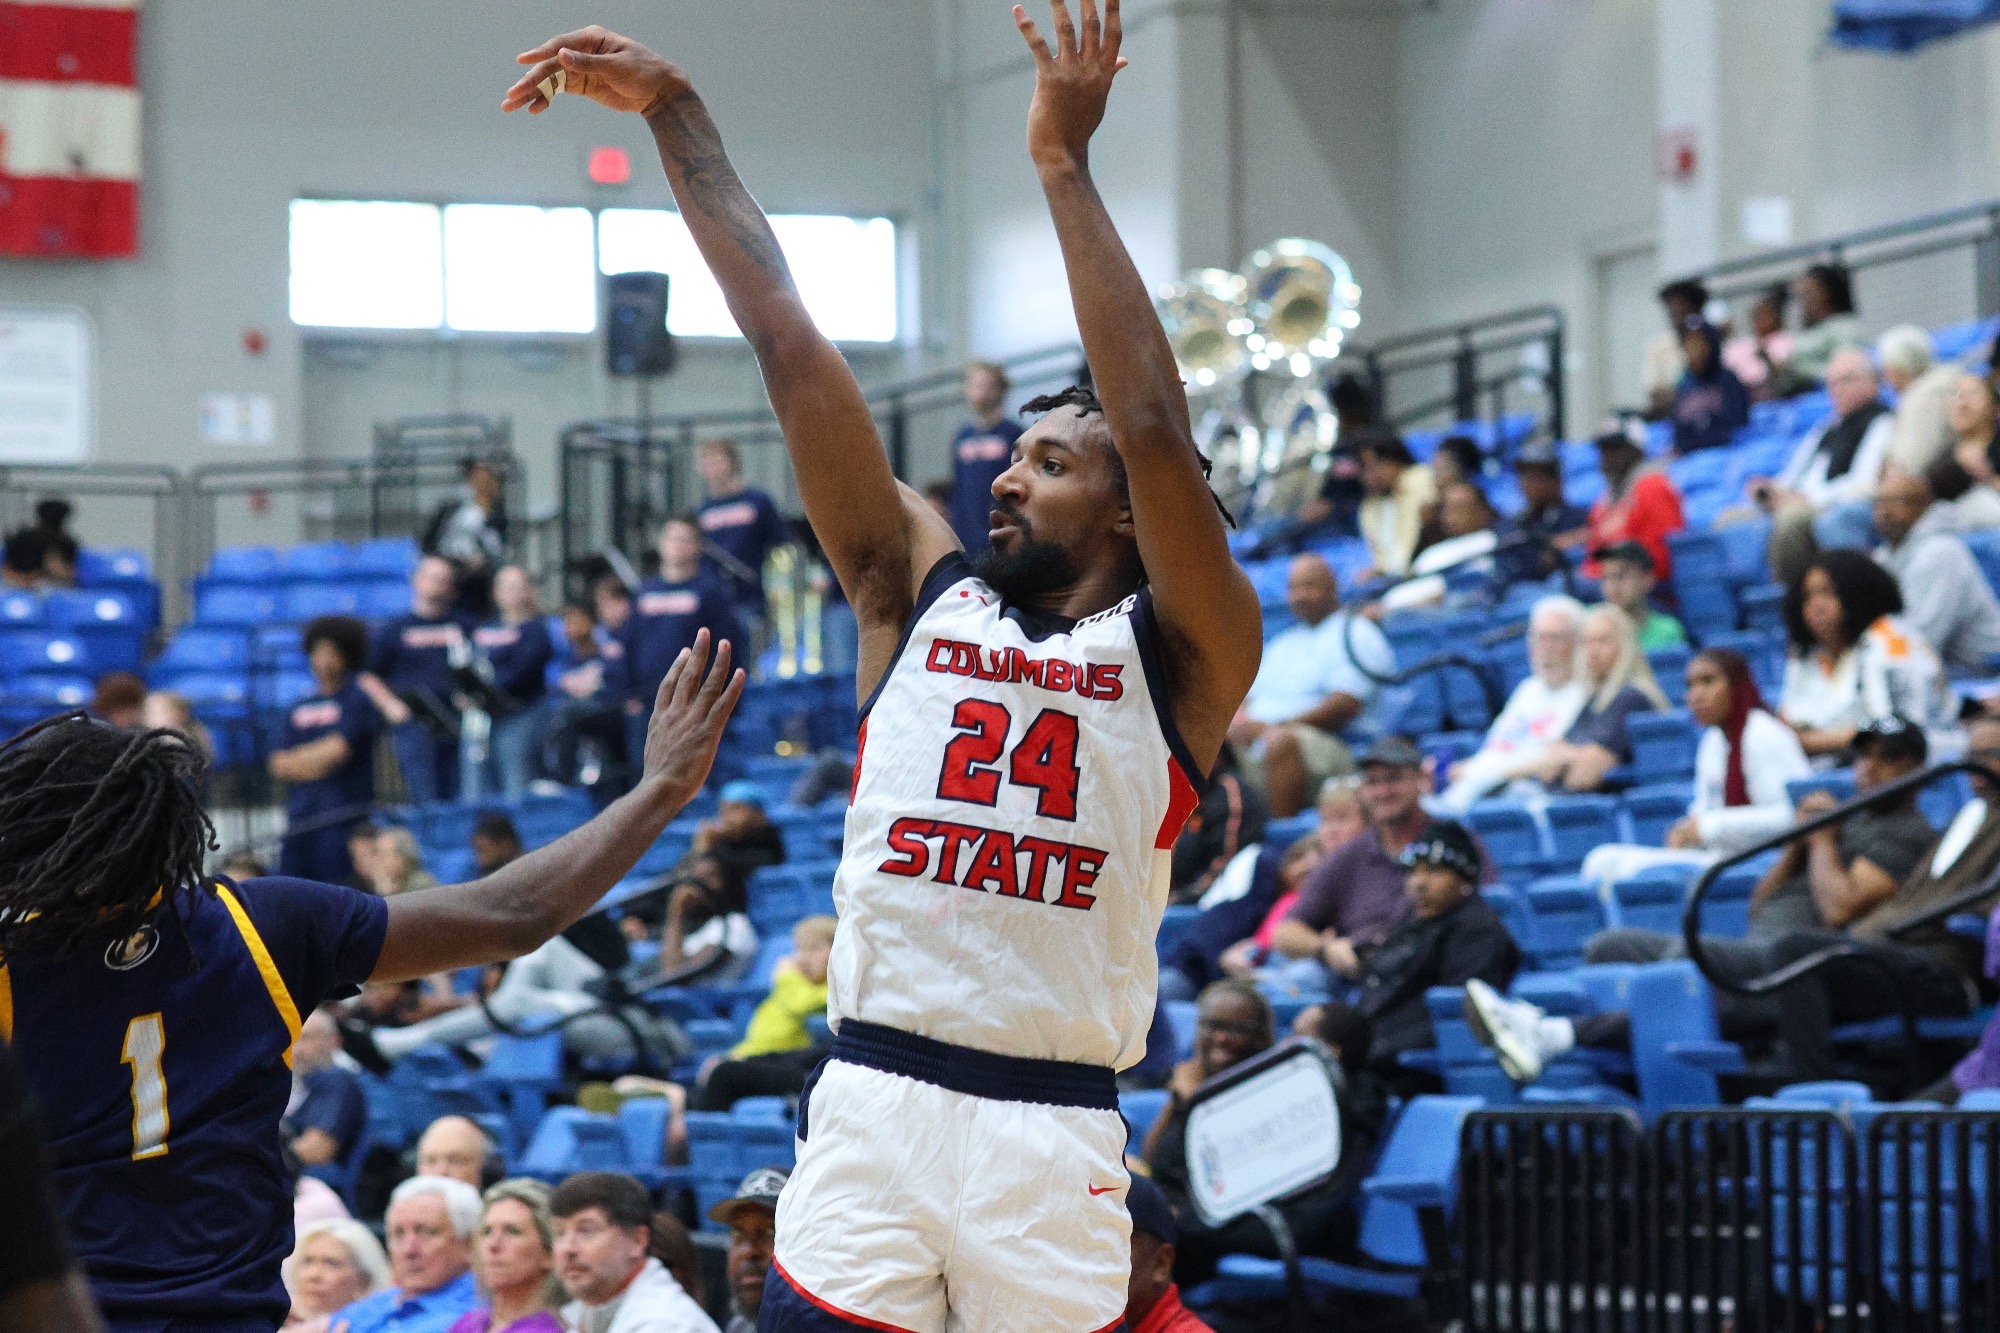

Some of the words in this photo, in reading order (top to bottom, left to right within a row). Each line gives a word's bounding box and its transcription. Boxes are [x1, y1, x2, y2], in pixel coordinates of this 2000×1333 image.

[926, 638, 1124, 701] COLUMBUS
[936, 698, 1081, 822] 24
[877, 817, 1109, 911] STATE
[120, 1012, 169, 1161] 1
